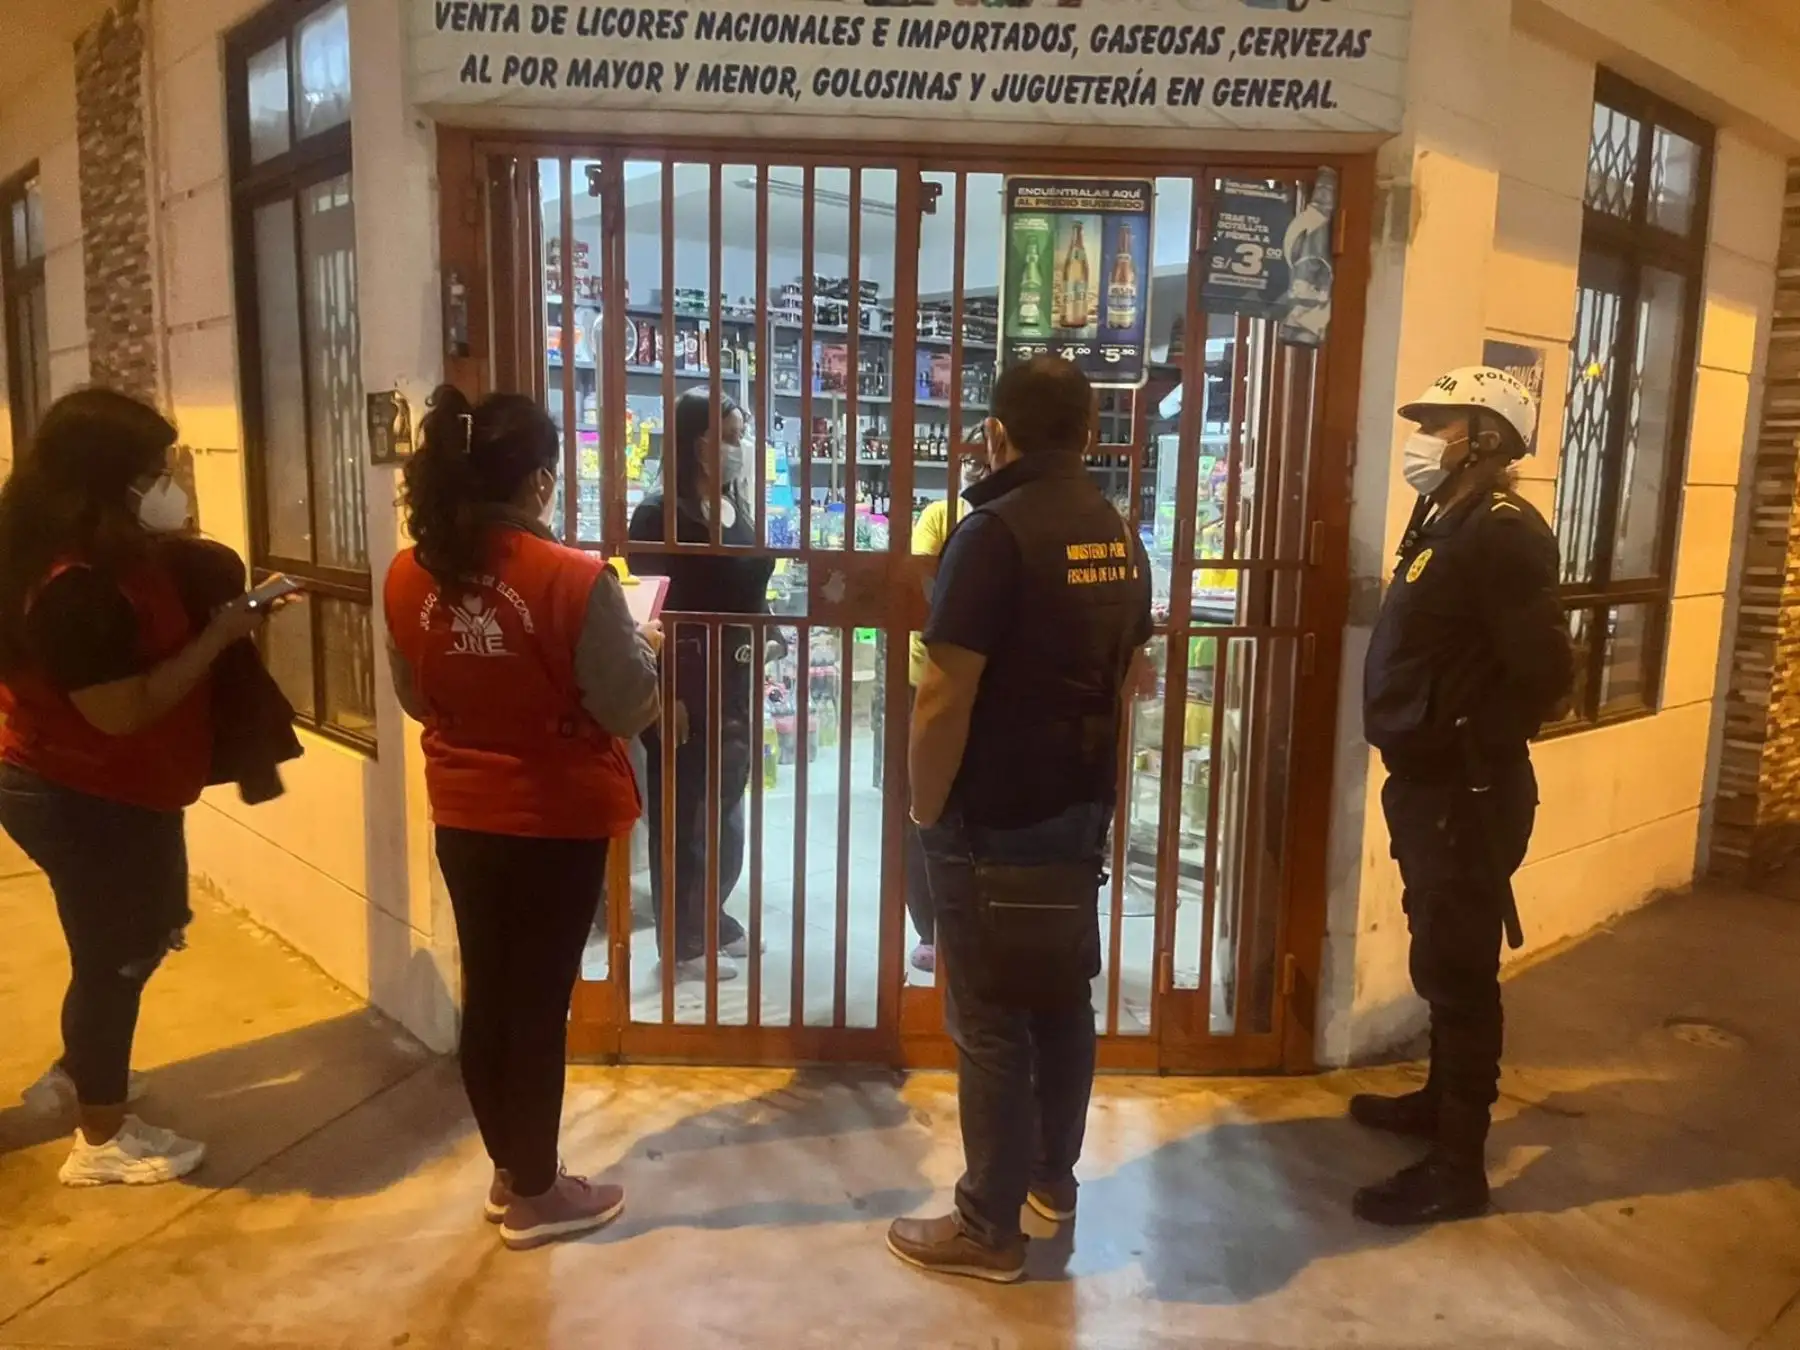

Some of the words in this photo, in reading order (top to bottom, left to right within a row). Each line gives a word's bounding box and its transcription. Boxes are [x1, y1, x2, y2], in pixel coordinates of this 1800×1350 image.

[435, 2, 521, 34] VENTA
[530, 5, 567, 36] DE
[576, 7, 689, 41] LICORES
[695, 11, 865, 47] NACIONALES
[872, 16, 891, 48] E
[897, 18, 1080, 59] IMPORTADOS,
[1090, 23, 1226, 56] GASEOSAS
[460, 53, 493, 84] AL
[502, 56, 558, 89] POR
[566, 58, 665, 94] MAYOR
[672, 62, 691, 92] Y
[695, 63, 802, 103] MENOR,
[812, 66, 958, 102] GOLOSINAS
[968, 72, 987, 102] Y
[991, 68, 1157, 108] JUGUETERÍA
[1167, 77, 1202, 107] EN
[1212, 78, 1339, 111] GENERAL.
[1112, 188, 1141, 198] AQUÍ
[1473, 371, 1530, 405] POLICA
[453, 632, 508, 655] JNE
